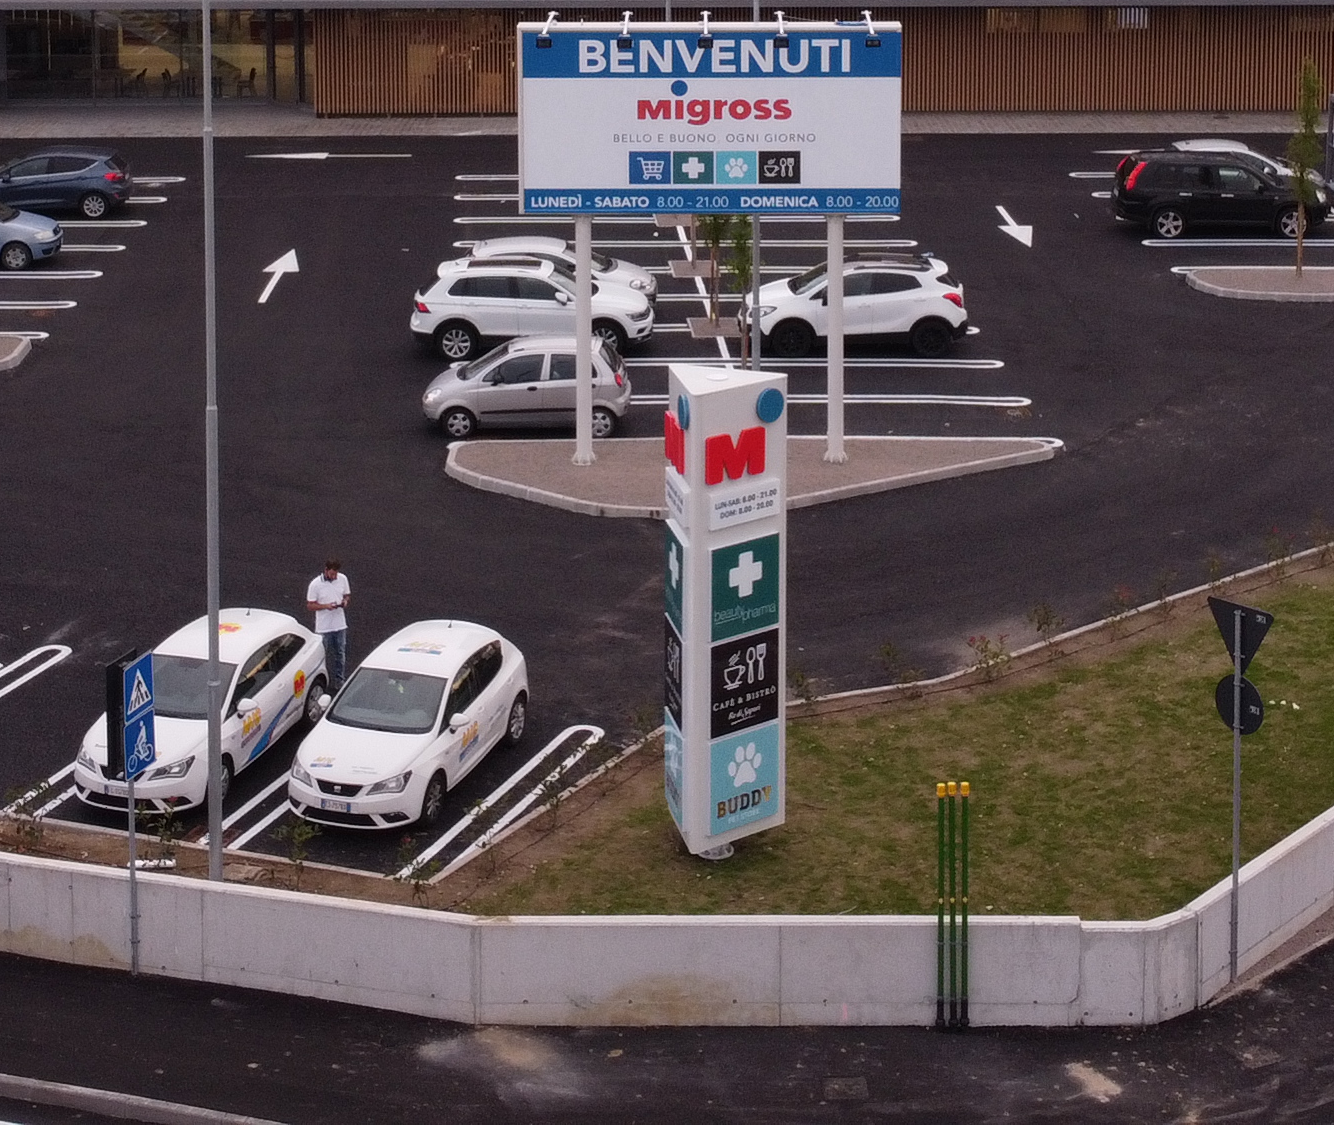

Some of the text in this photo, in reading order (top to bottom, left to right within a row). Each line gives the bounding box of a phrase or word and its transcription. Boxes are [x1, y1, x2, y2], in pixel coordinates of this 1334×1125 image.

[578, 39, 851, 73] BENVENUTI
[637, 80, 792, 125] Migross
[613, 133, 816, 143] BELLO E BUONO OGNI GIORNO
[531, 194, 582, 208] LUNEDÌ
[594, 196, 649, 208] SABATO
[657, 196, 683, 208] 8.00
[697, 196, 729, 208] 21.00
[740, 196, 818, 208] DOMENICA
[826, 196, 852, 208] 8.00
[865, 196, 899, 208] 20.00
[705, 426, 766, 485] M
[717, 785, 772, 819] BUDDY
